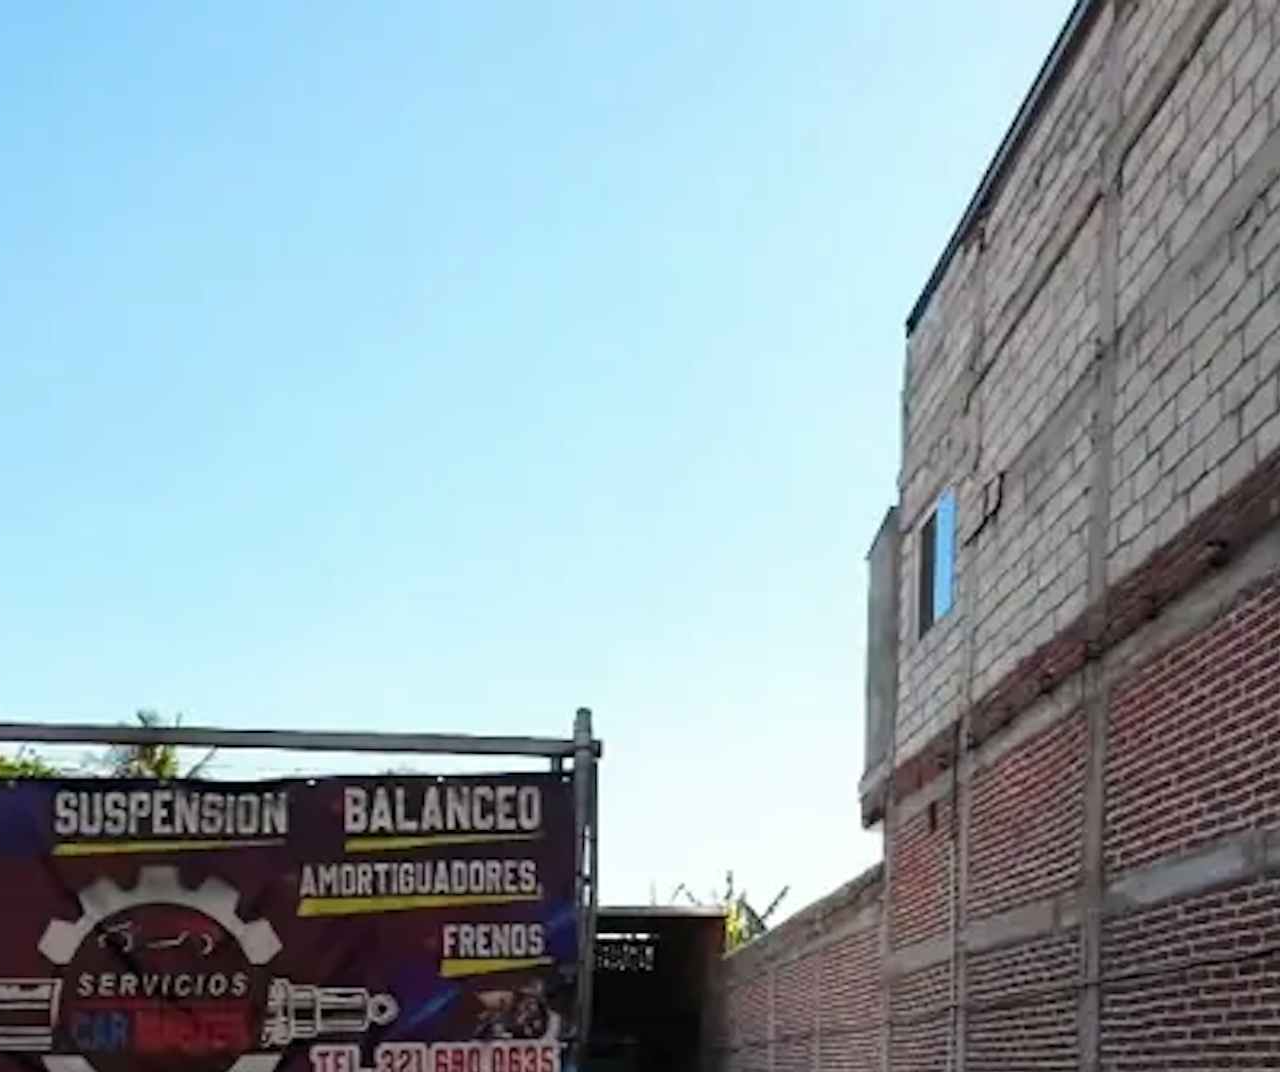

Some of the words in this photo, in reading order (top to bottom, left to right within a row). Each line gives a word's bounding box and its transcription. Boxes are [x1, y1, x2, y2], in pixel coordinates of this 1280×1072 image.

[53, 788, 289, 835] SUSPENSION
[342, 784, 543, 833] BALANCEO
[442, 922, 546, 958] FRENOS
[76, 972, 249, 998] SERVICIOS
